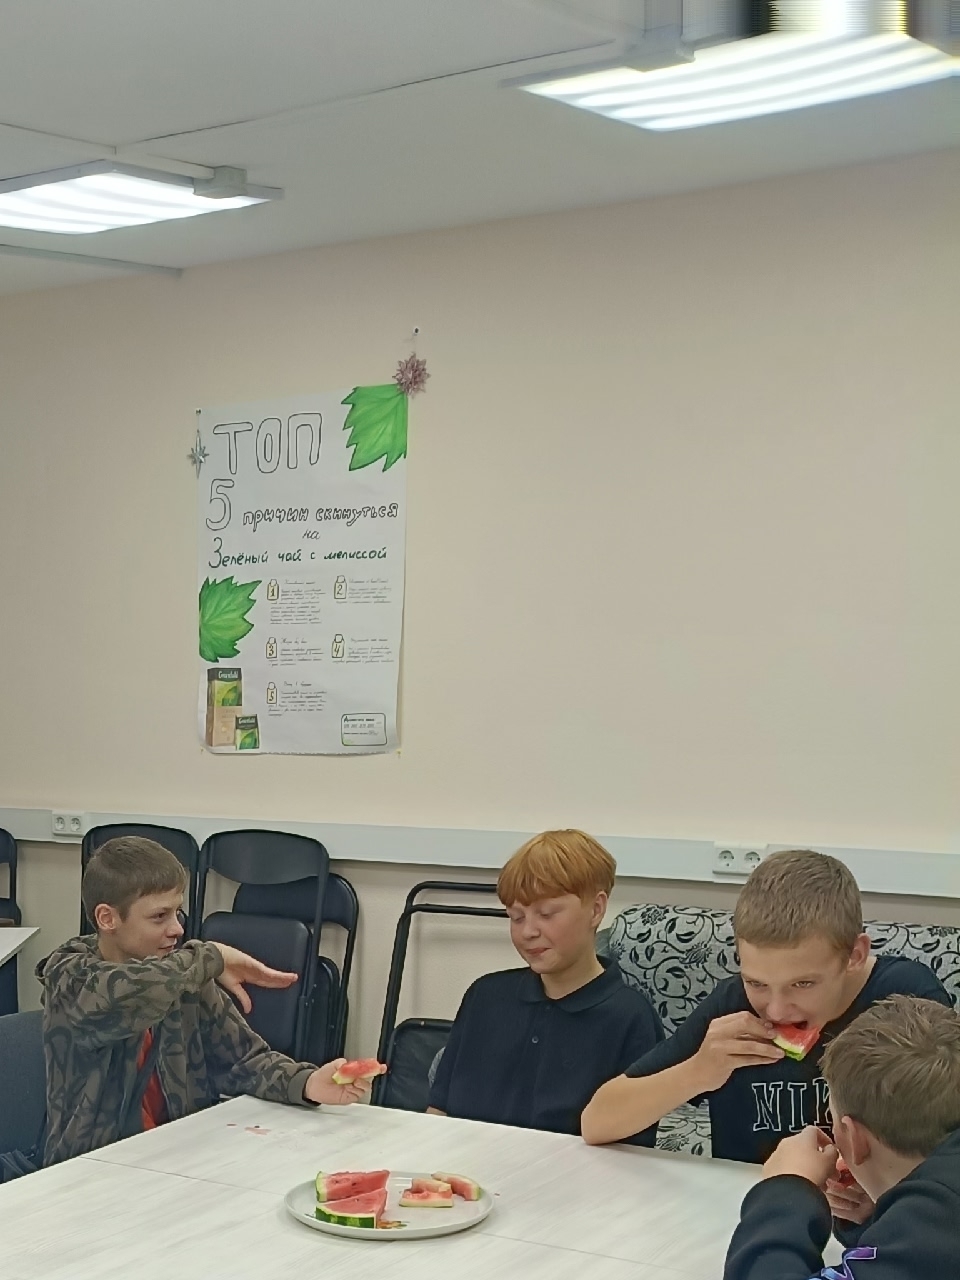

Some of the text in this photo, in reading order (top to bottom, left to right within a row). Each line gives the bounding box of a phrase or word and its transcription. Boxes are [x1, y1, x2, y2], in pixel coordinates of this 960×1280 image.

[213, 412, 323, 475] ТОП
[205, 478, 399, 533] 5 причин скинуться
[208, 536, 388, 569] Зелёный чай с мелиссой
[302, 528, 321, 540] на
